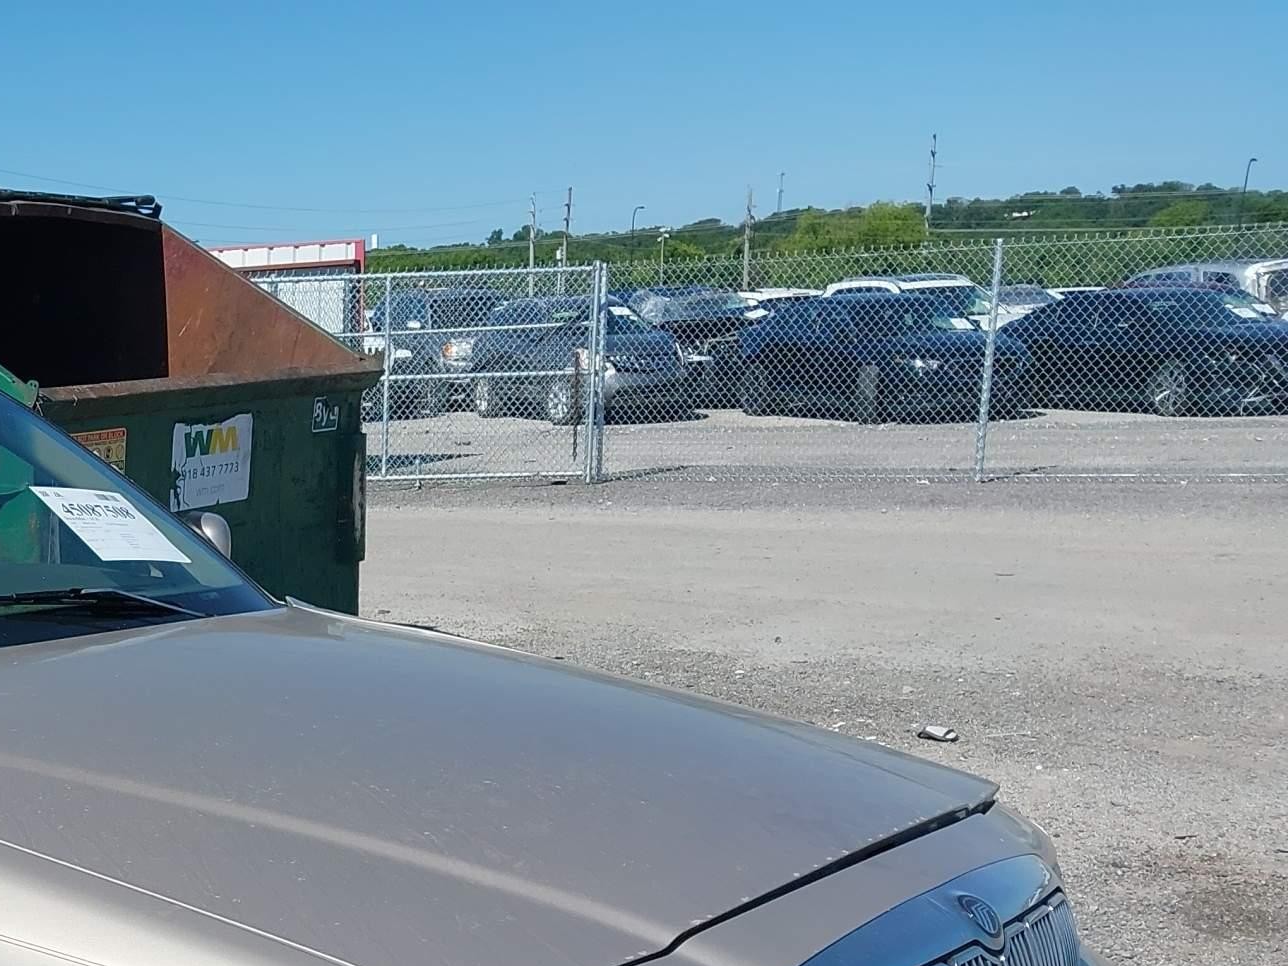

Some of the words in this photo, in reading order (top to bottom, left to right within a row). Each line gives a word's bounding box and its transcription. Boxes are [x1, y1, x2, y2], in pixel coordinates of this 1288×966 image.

[184, 426, 238, 458] WM
[200, 465, 217, 477] 437
[219, 461, 239, 475] 7773
[62, 503, 136, 520] 45087508
